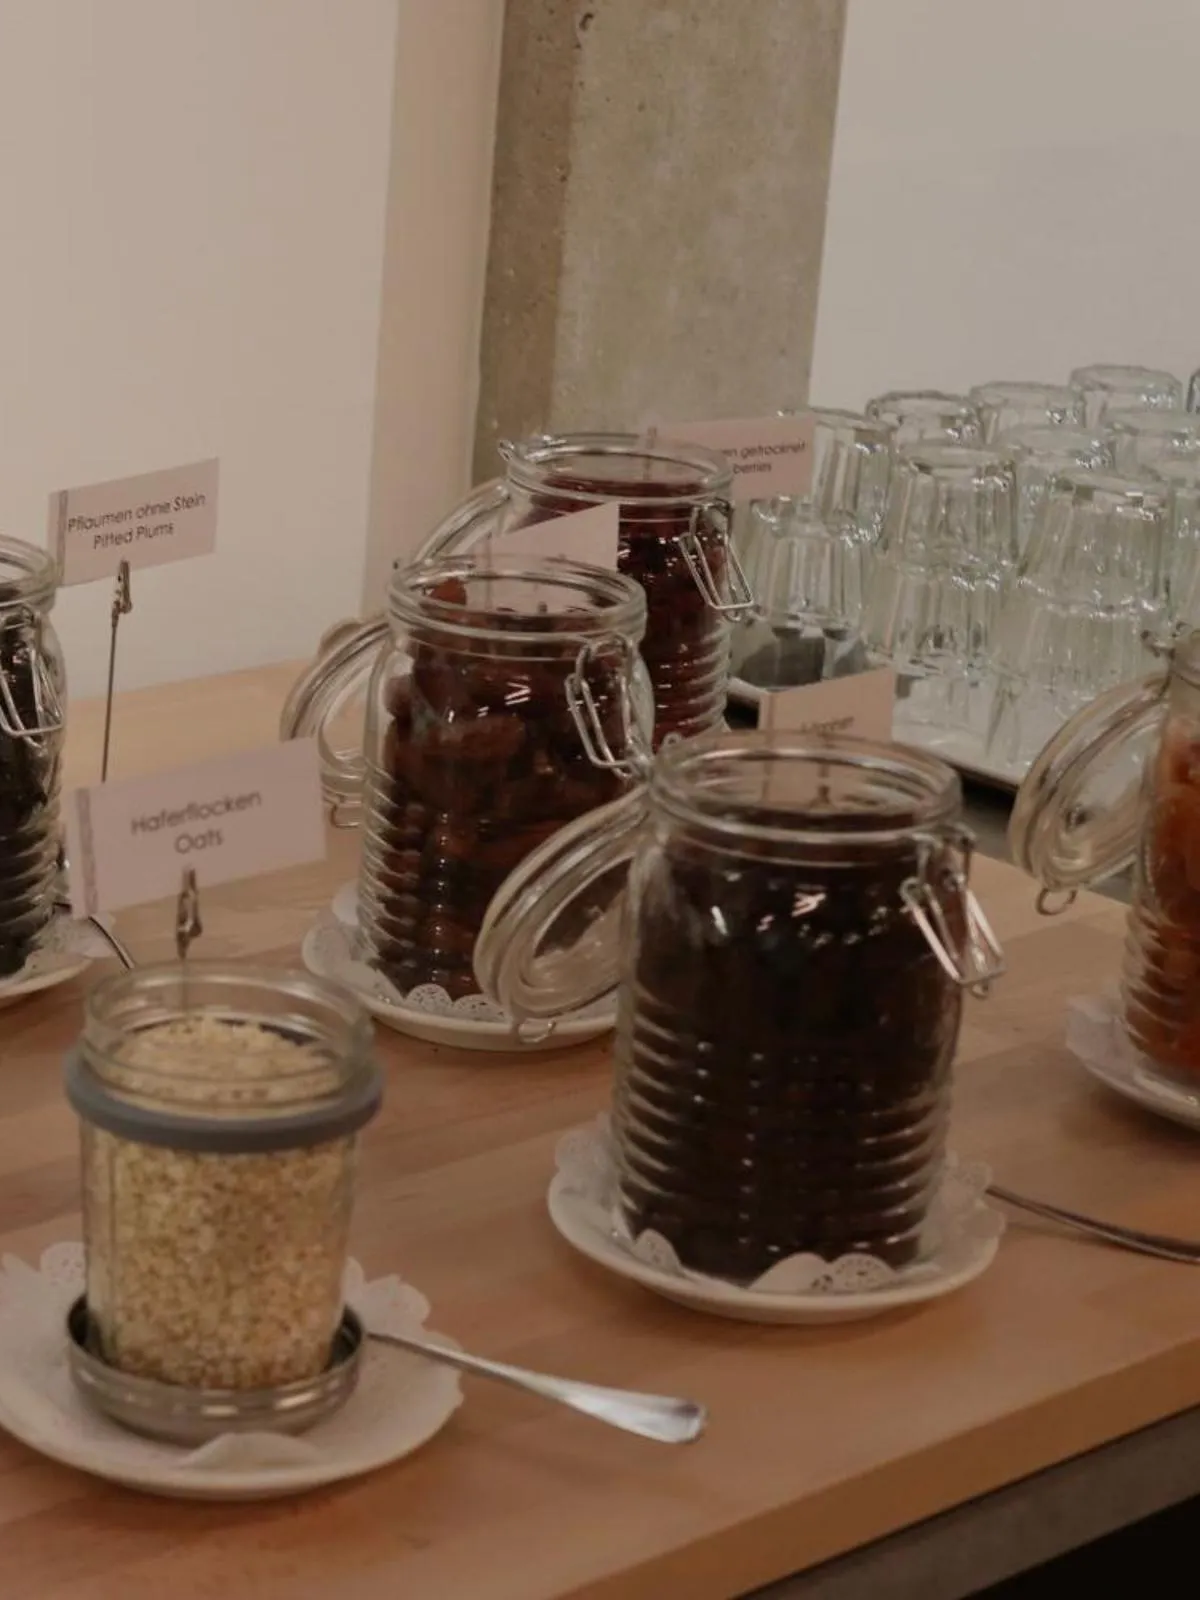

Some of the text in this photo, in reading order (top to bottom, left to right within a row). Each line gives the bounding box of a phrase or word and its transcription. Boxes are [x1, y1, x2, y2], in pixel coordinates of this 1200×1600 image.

[67, 492, 206, 533] Pflaumen ohne Stein
[93, 522, 175, 550] Pitted Plums
[131, 791, 262, 836] Haferflocken
[174, 829, 223, 855] Oats
